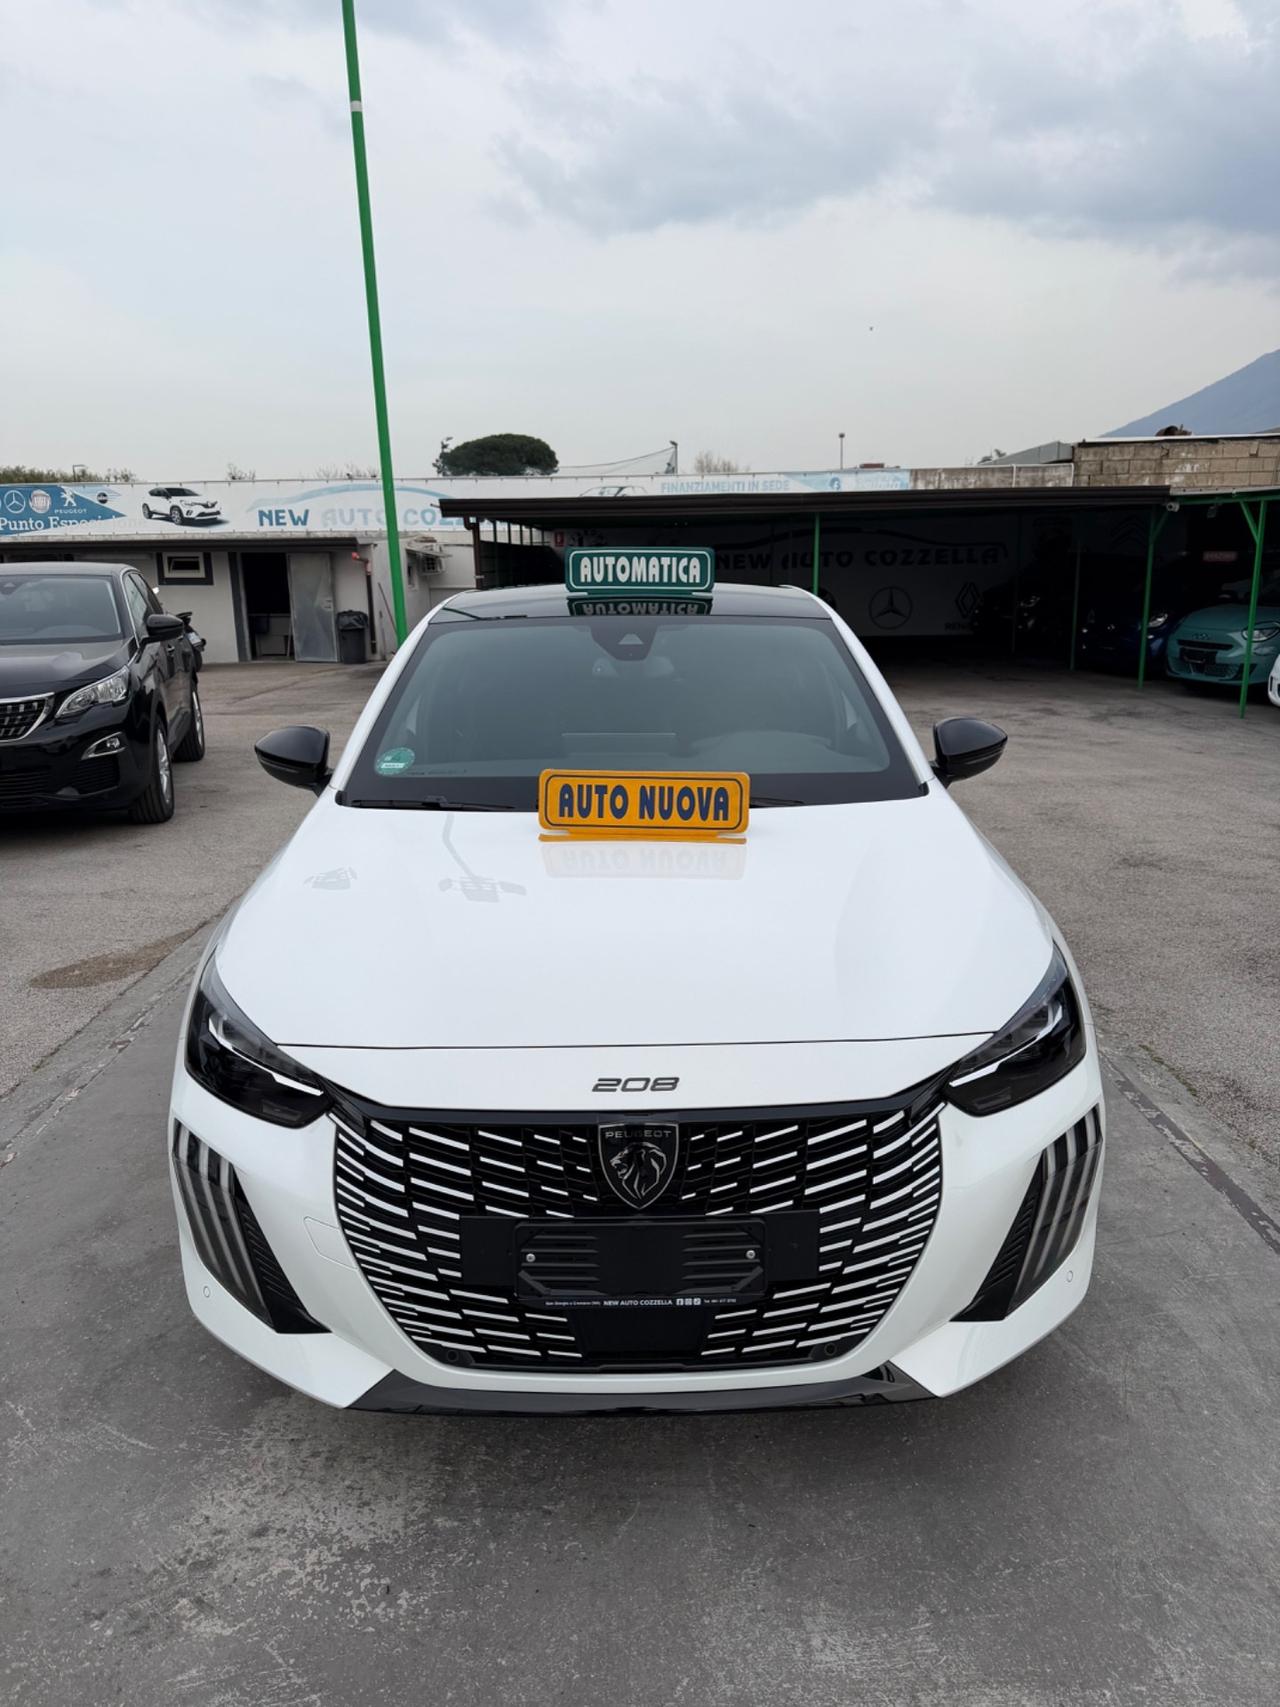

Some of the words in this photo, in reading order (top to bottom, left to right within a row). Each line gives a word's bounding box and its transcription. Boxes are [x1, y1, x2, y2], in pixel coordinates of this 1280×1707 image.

[661, 480, 746, 493] FINANZIAMENTI
[748, 480, 759, 491] IN
[761, 479, 790, 491] SEDE
[0, 517, 44, 531] Punto
[258, 508, 310, 527] NEW
[716, 553, 770, 569] NEW
[865, 548, 999, 566] COZZELLA
[580, 556, 702, 583] AUTOMATICA
[559, 783, 629, 820] AUTO
[639, 785, 730, 822] NUOVA
[592, 1077, 680, 1092] 208
[605, 1130, 672, 1139] PEUGEOT
